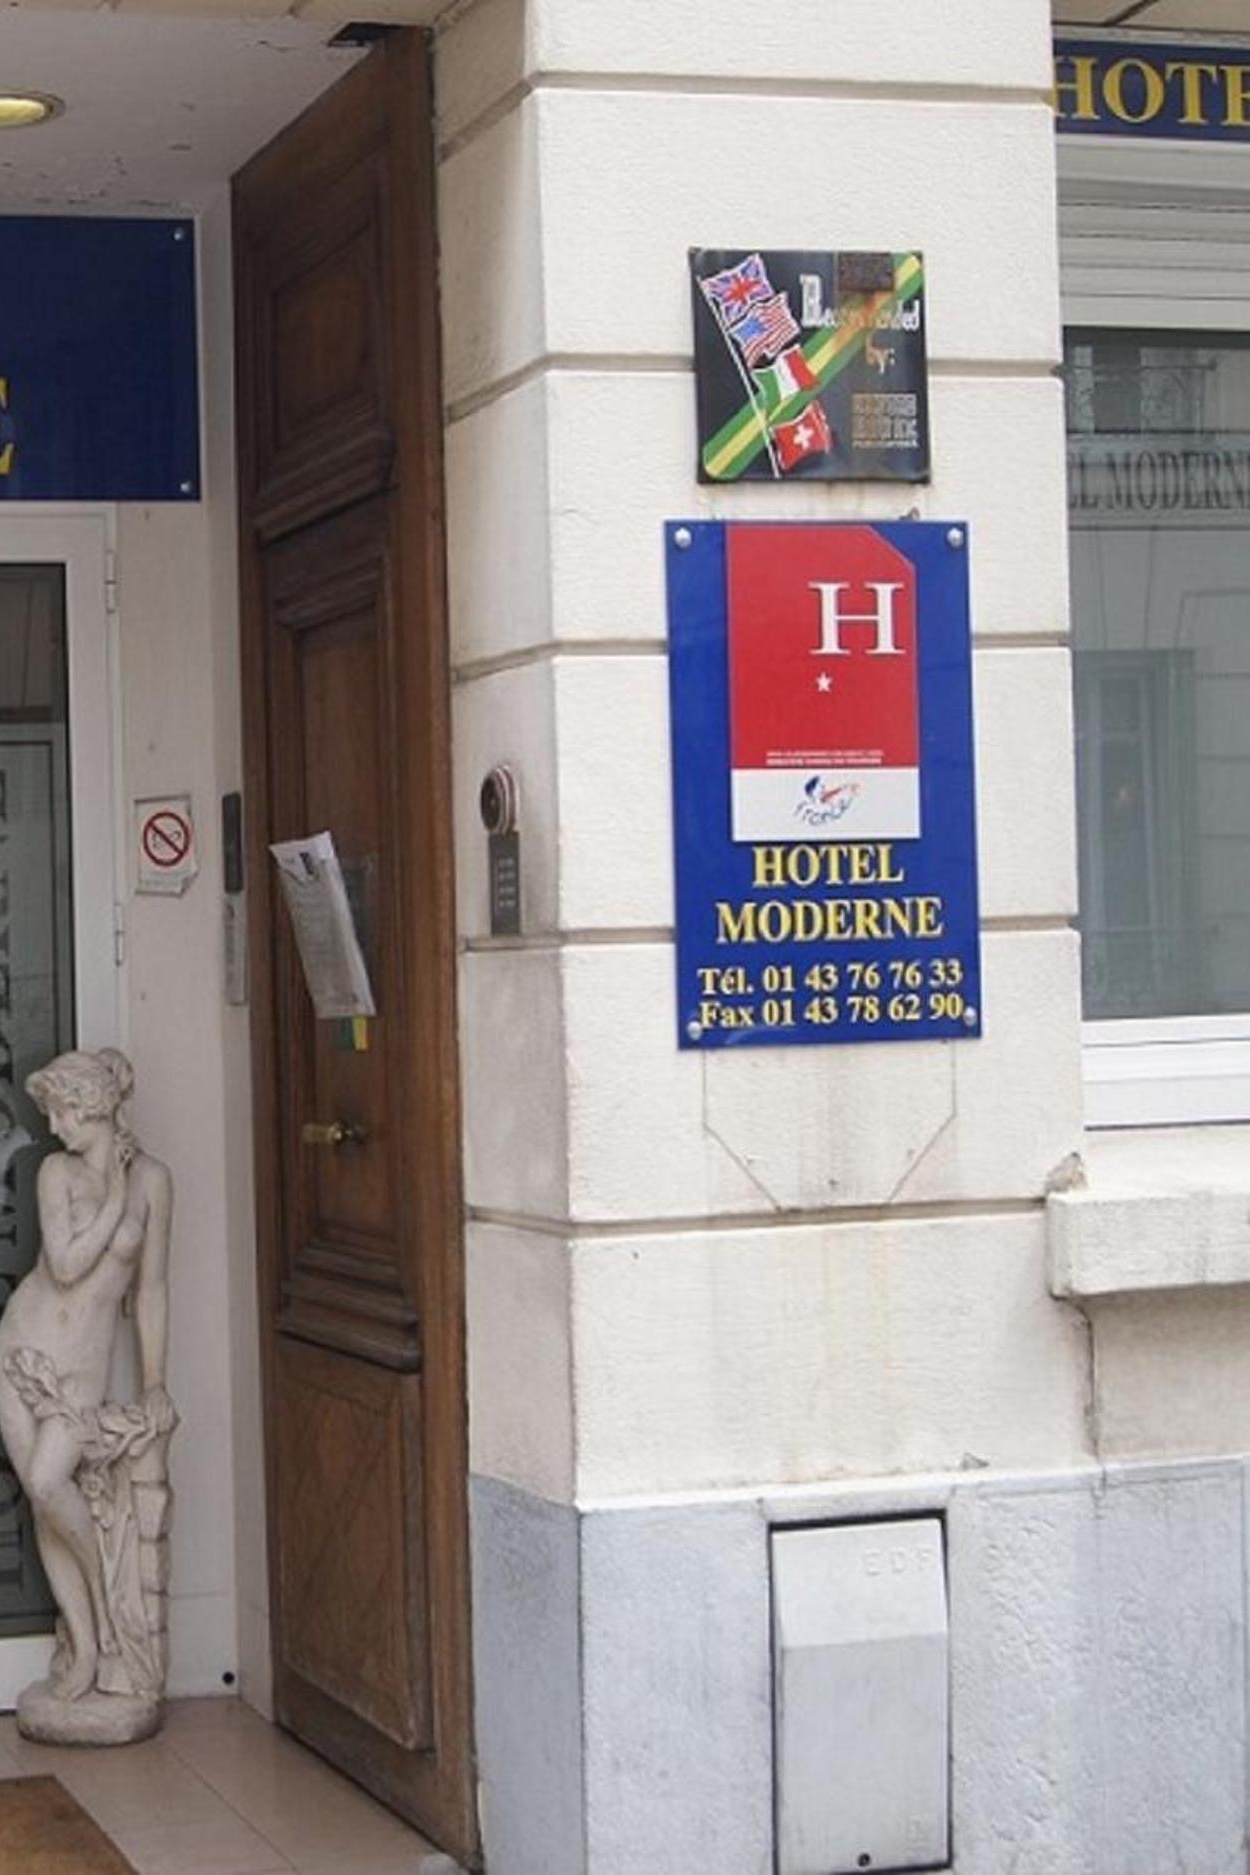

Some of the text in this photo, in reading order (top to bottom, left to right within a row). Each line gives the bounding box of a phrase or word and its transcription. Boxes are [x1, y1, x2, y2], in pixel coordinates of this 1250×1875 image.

[808, 581, 907, 657] H
[752, 844, 905, 888] HOTEL
[715, 896, 944, 945] MODERNE
[696, 958, 964, 995] Tél. 01 43 76 76 33
[699, 992, 964, 1029] Fax 01 43 78 62 90
